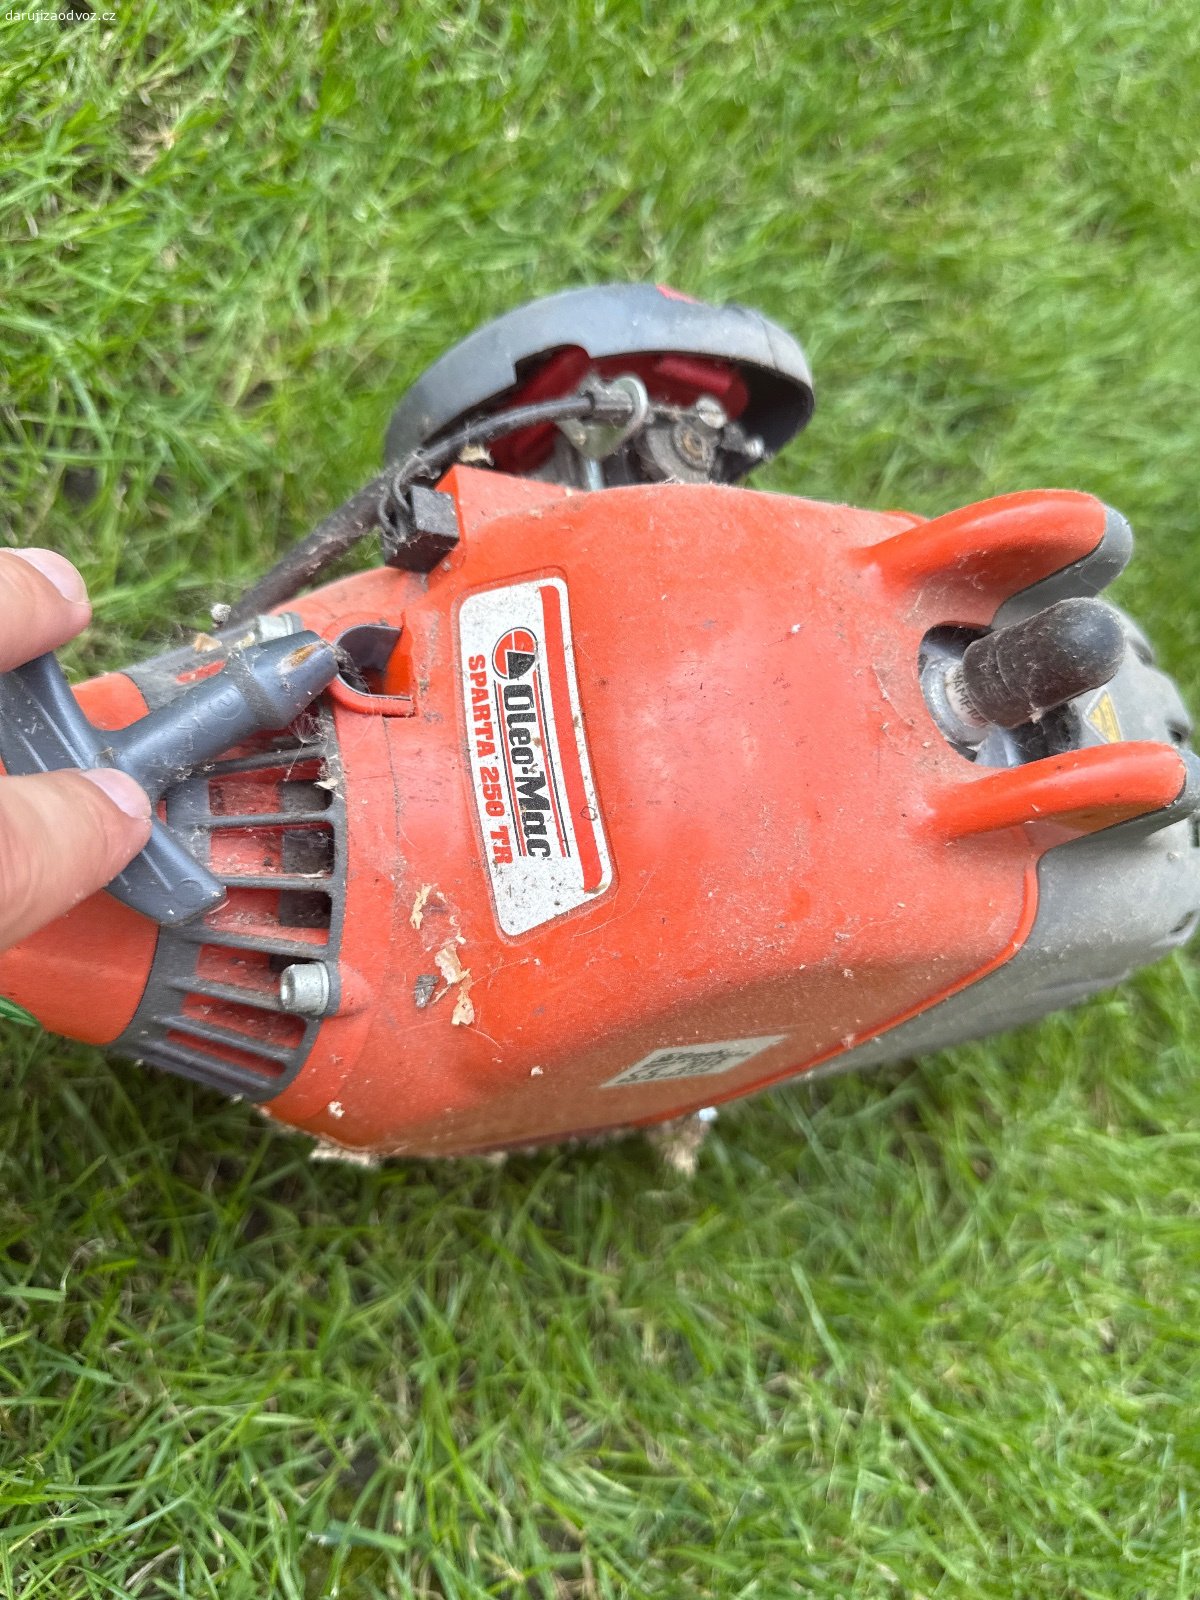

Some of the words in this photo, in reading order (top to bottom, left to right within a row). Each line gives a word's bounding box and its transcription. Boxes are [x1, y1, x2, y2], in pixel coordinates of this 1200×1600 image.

[468, 654, 497, 759] SPARTA
[479, 766, 504, 816] 250
[503, 684, 553, 858] Oleo-Mac
[490, 826, 514, 865] TR
